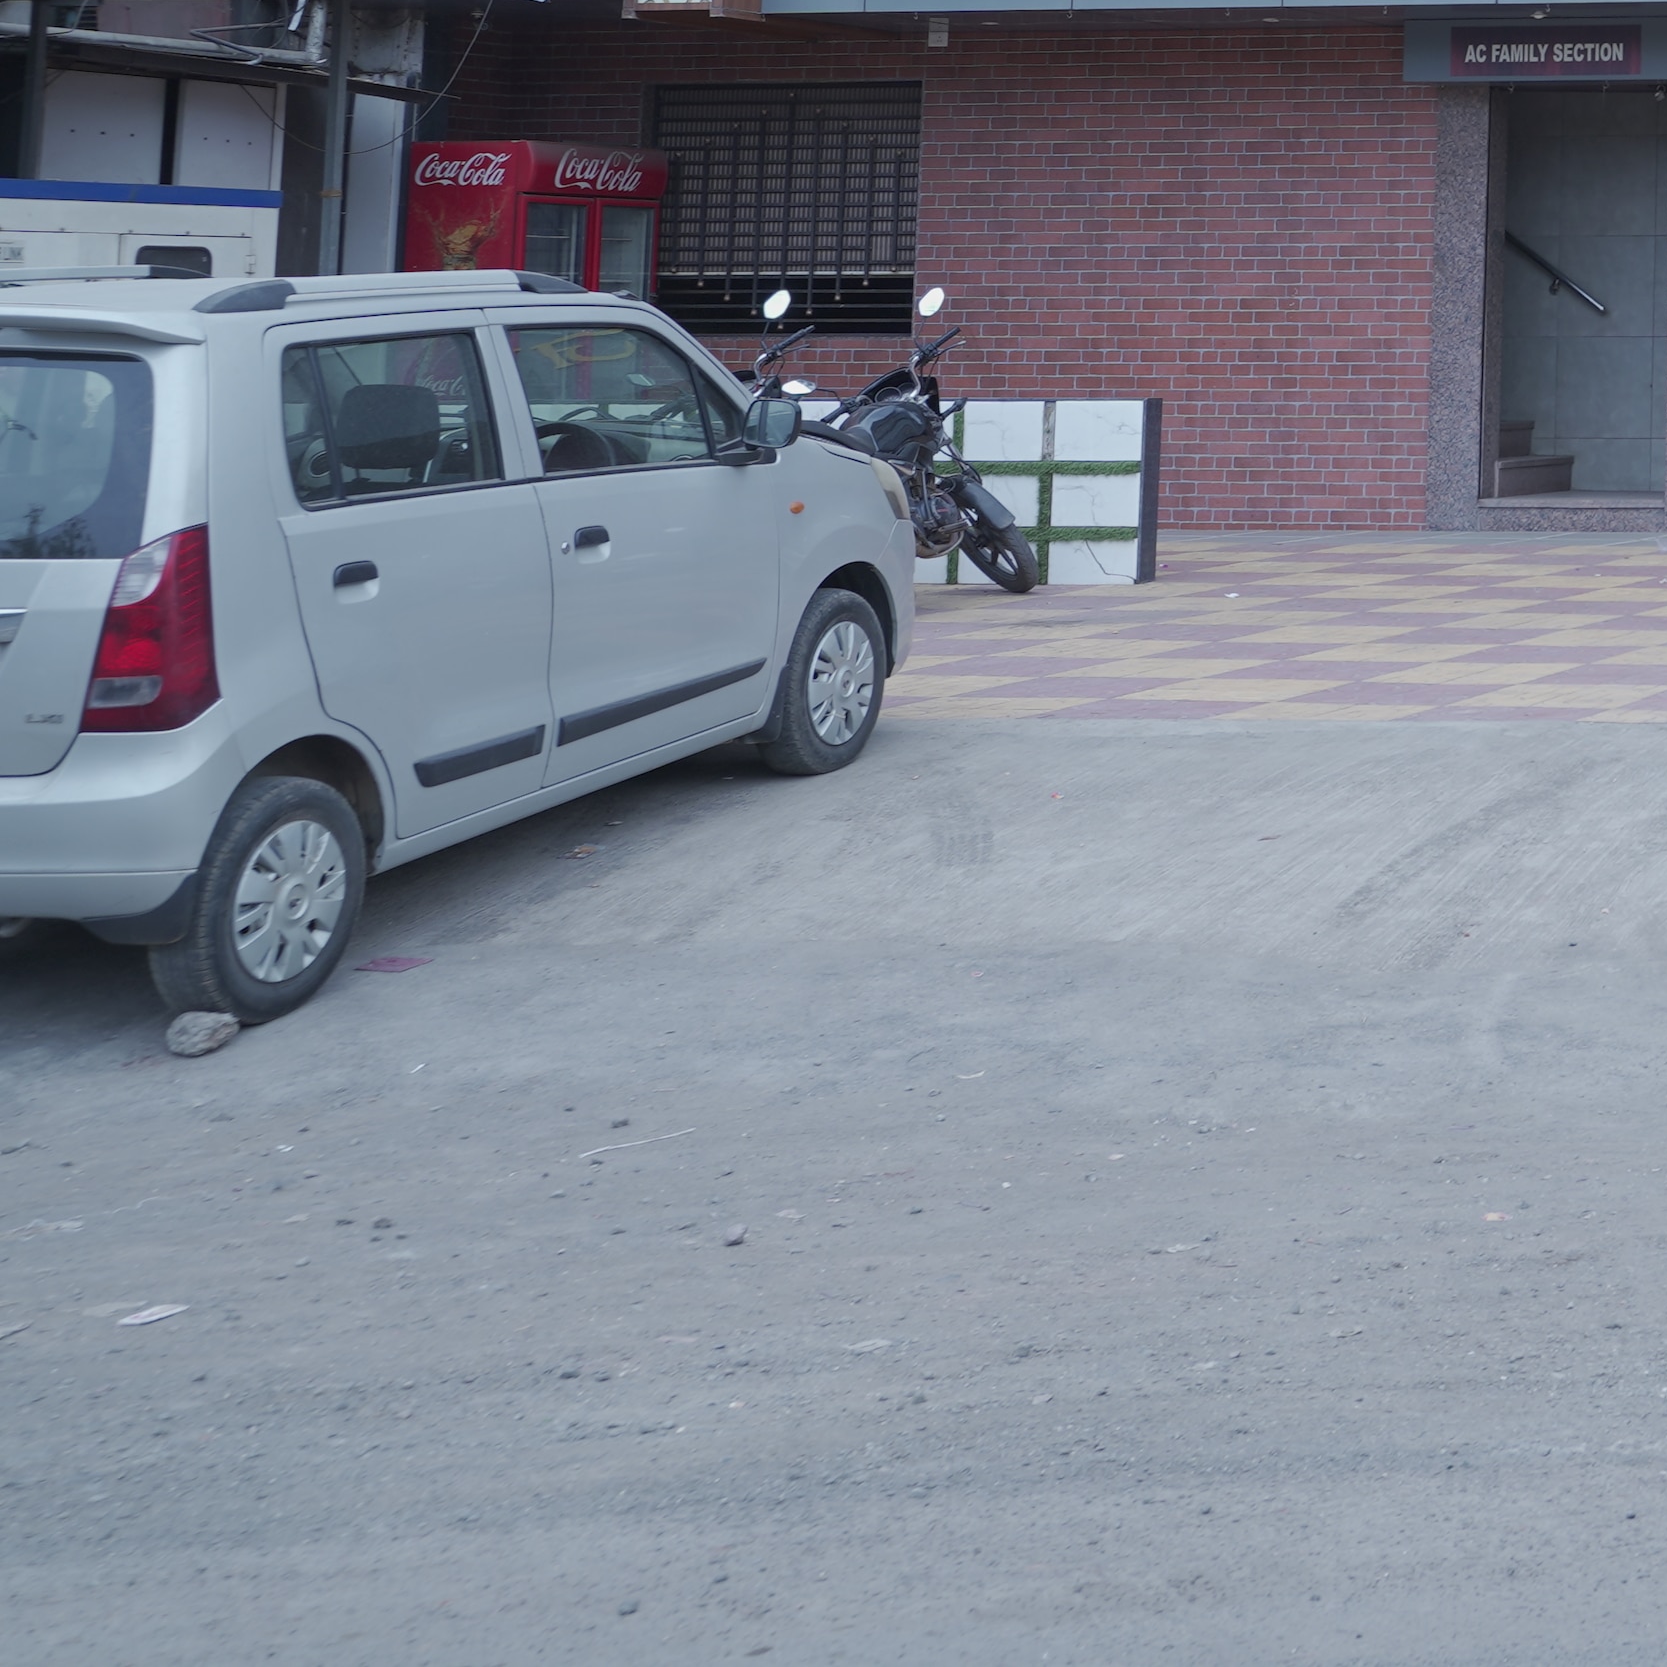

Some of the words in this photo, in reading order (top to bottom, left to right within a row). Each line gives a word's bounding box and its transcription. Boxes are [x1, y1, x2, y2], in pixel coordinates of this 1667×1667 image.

[1464, 44, 1489, 63] AC
[1491, 43, 1549, 63] FAMILY
[1552, 42, 1624, 62] SECTION
[415, 152, 513, 187] Coca-Cola
[554, 148, 646, 193] Coca-Cola
